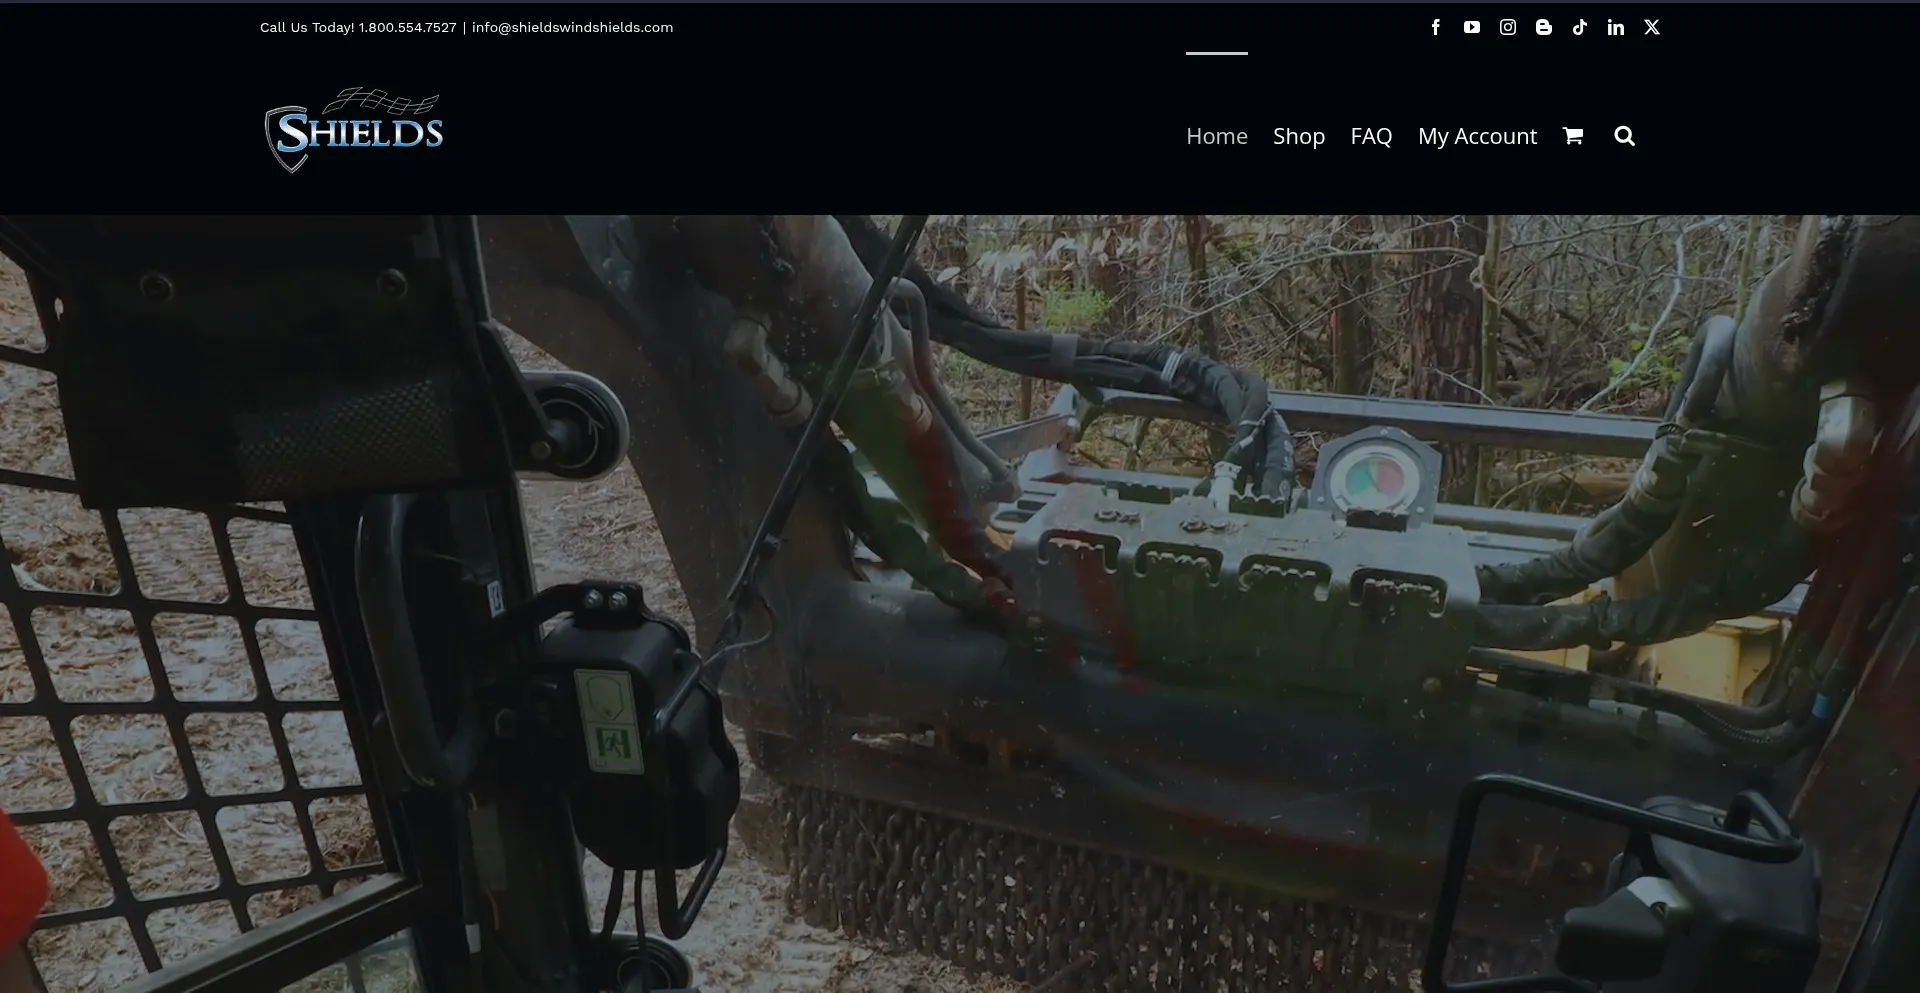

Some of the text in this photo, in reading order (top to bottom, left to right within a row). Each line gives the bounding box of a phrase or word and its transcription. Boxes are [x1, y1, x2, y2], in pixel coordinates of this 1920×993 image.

[260, 21, 287, 33] Call
[291, 22, 308, 33] Us
[311, 21, 355, 36] Today!
[358, 22, 457, 33] 1.800.554.7527
[472, 21, 674, 36] info@shieldswindshields.com
[1187, 127, 1248, 145] Home
[1273, 127, 1326, 150] Shop
[1351, 127, 1393, 149] FAQ
[1419, 127, 1538, 150] My Account
